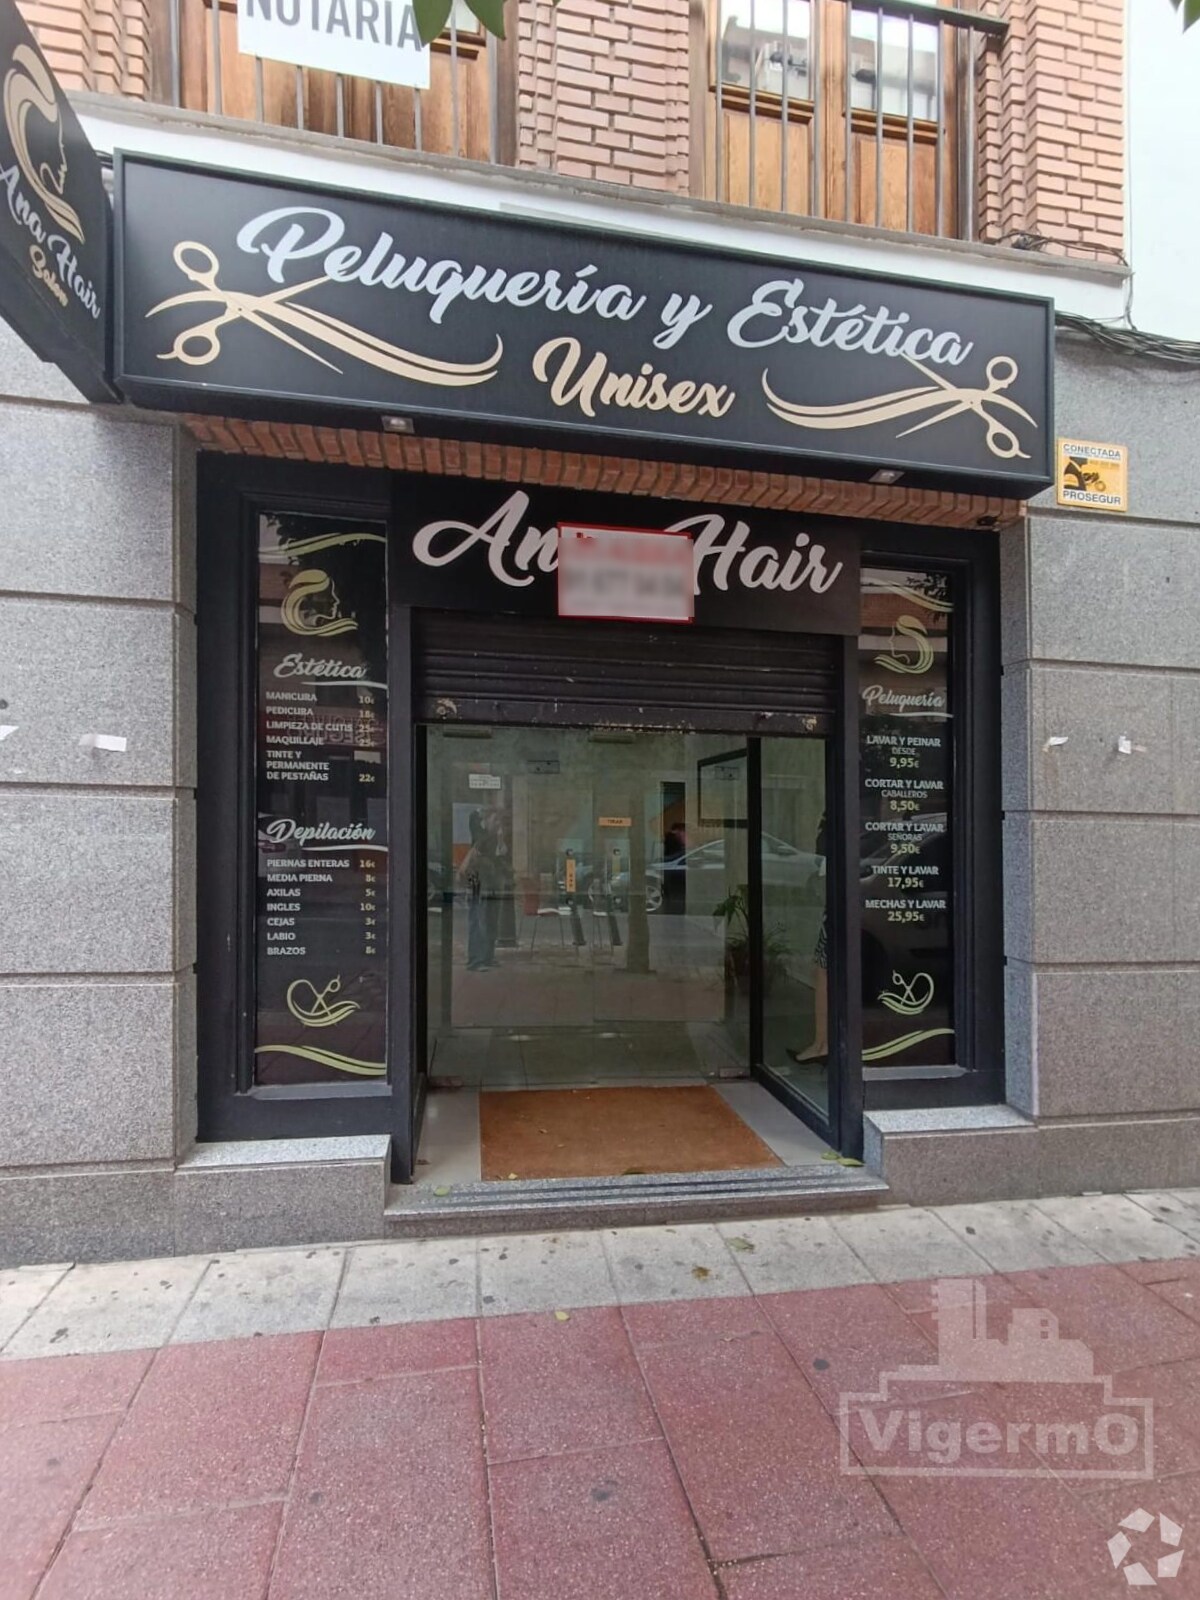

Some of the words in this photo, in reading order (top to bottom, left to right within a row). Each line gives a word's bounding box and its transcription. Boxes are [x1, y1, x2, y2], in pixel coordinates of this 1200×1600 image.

[47, 235, 101, 320] Hair
[236, 206, 647, 325] Peluquería
[659, 291, 713, 350] y
[727, 279, 974, 366] Estética
[532, 336, 736, 419] Unisex
[1063, 443, 1121, 458] CONECTADA
[1063, 490, 1121, 505] PROSEGUR
[412, 490, 560, 588] An
[663, 513, 843, 596] Hair
[273, 652, 368, 679] Estética
[265, 691, 318, 702] MANICURA
[862, 684, 946, 713] Peluquería
[265, 706, 314, 716] PEDICURA
[265, 721, 309, 731] LIMPIEZA
[310, 722, 324, 731] DE
[325, 723, 354, 732] CUTIS
[265, 735, 325, 746] MAQUILLAJE
[866, 735, 898, 746] LAVAR
[899, 736, 906, 745] Y
[907, 737, 942, 747] PEINAR
[266, 750, 294, 759] TINTE
[295, 751, 303, 760] Y
[266, 761, 330, 771] PERMANENTE
[889, 757, 920, 769] 9,95€
[266, 771, 280, 780] DE
[281, 771, 329, 781] PESTAÑAS
[864, 778, 904, 788] CORTAR
[905, 780, 912, 788] Y
[913, 780, 945, 790] LAVAR
[881, 789, 928, 799] CABALLEROS
[266, 818, 377, 846] Depilación
[864, 822, 904, 831] CORTAR
[905, 823, 912, 831] Y
[913, 823, 945, 833] LAVAR
[266, 859, 307, 868] PIERNAS
[308, 859, 350, 868] ENTERAS
[872, 865, 899, 874] TINTE
[900, 866, 907, 875] Y
[908, 866, 939, 876] LAVAR
[266, 873, 298, 882] MEDIA
[299, 873, 333, 882] PIERNA
[266, 888, 301, 897] AXILAS
[266, 903, 301, 912] INGLES
[865, 899, 906, 909] MECHAS
[907, 900, 915, 909] Y
[916, 900, 946, 909] LAVAR
[266, 917, 295, 927] CEJAS
[887, 911, 925, 923] 25,95€
[266, 932, 296, 941] LABIO
[266, 946, 306, 956] BRAZOS
